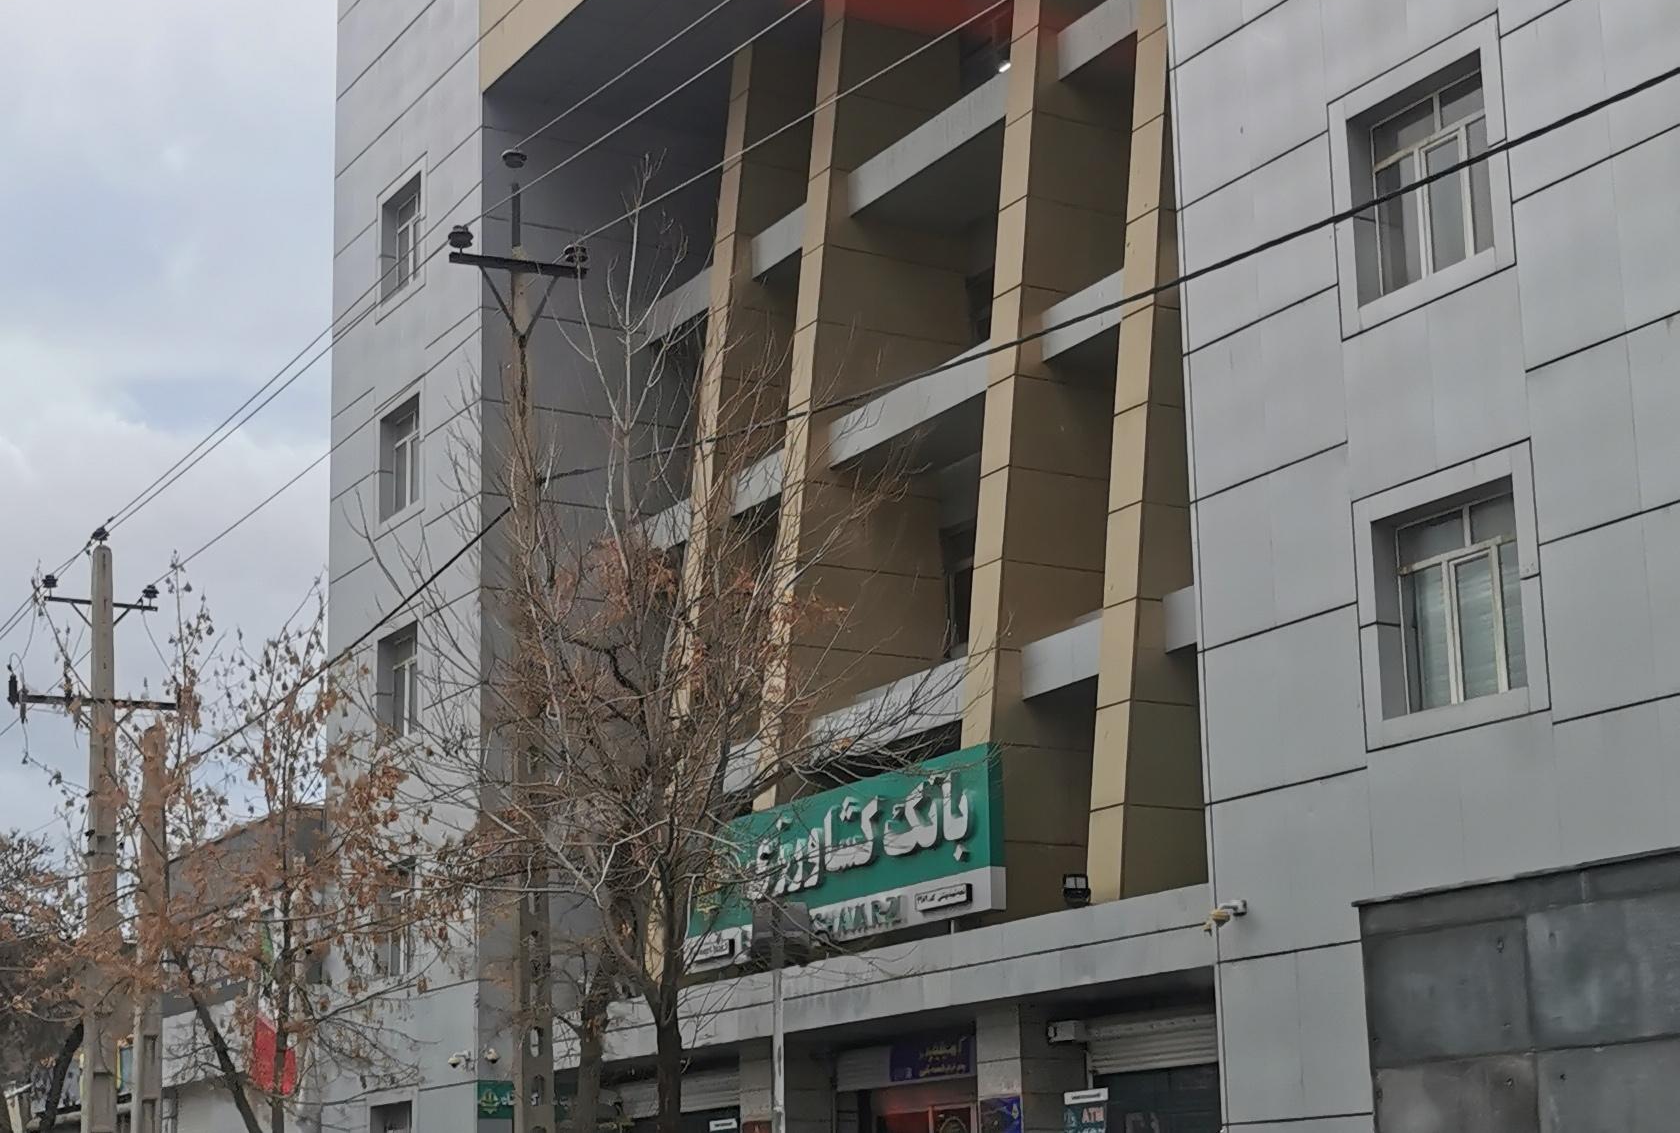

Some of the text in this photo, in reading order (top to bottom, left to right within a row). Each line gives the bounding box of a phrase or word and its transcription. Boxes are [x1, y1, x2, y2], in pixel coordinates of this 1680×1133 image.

[744, 770, 972, 901] بانک کشاورزی
[1081, 1106, 1105, 1124] ATM
